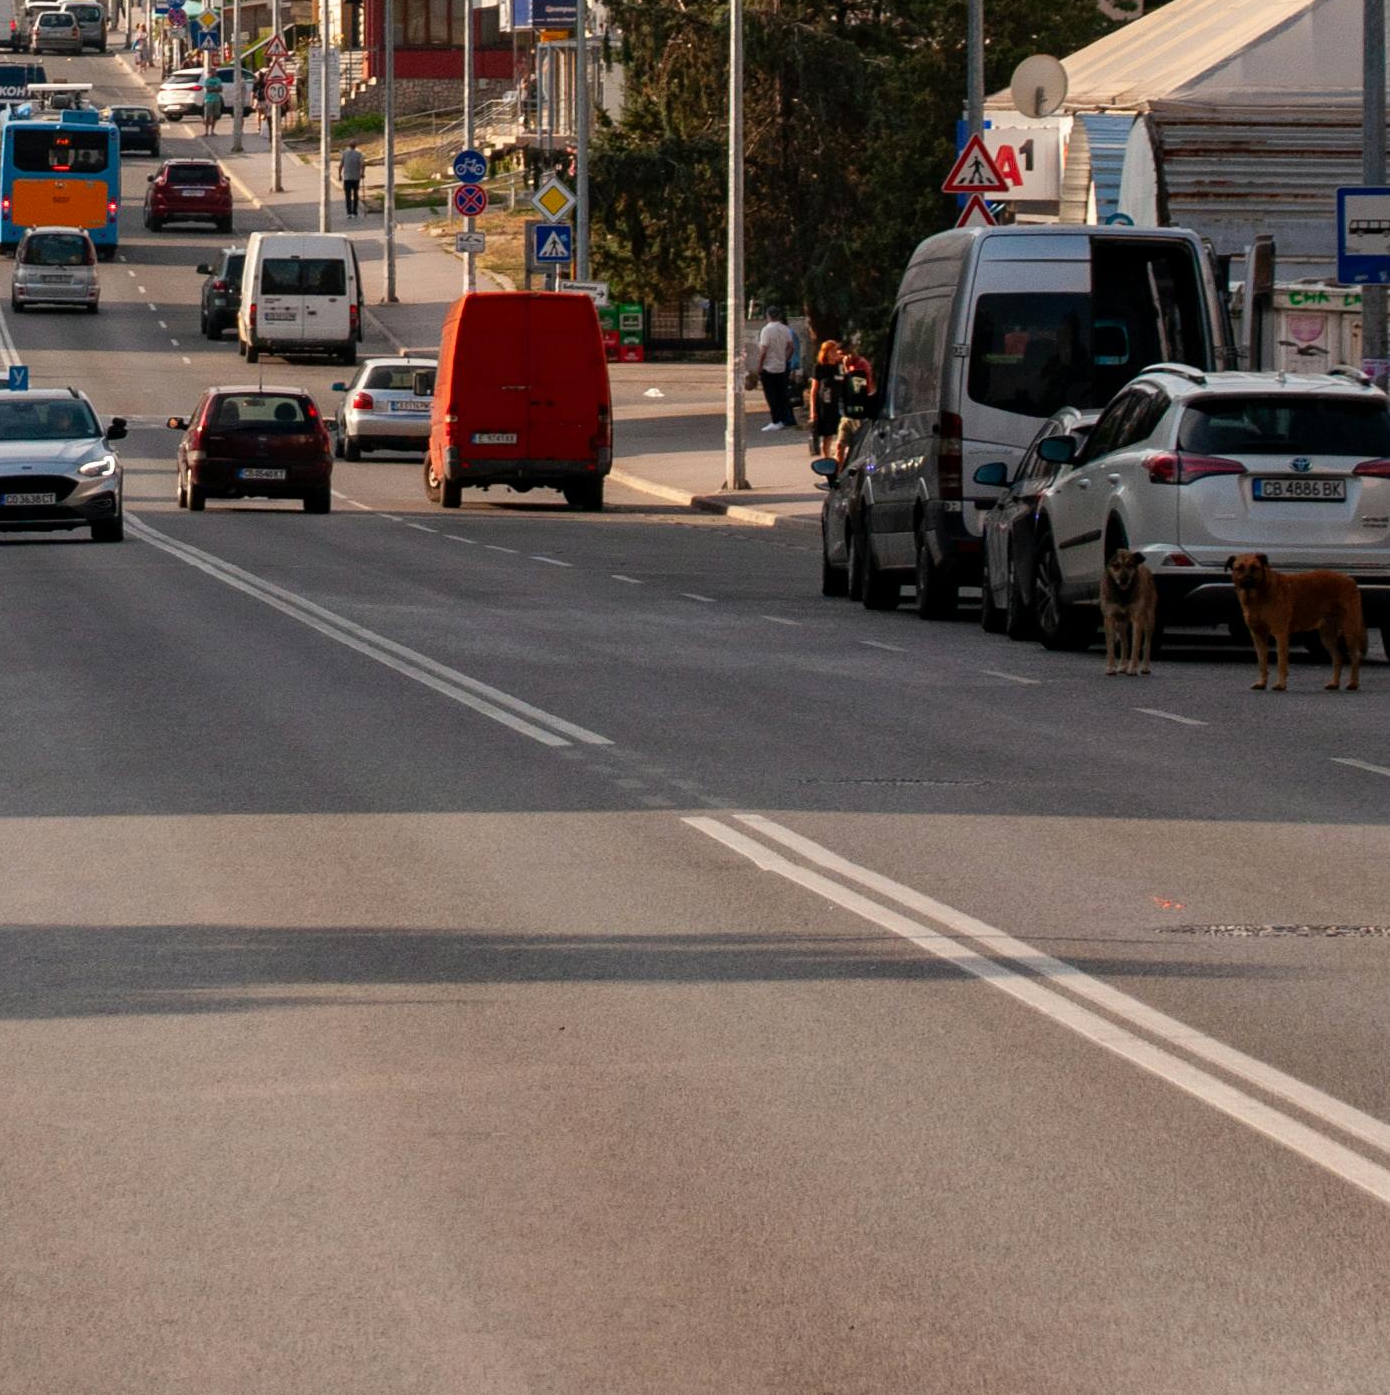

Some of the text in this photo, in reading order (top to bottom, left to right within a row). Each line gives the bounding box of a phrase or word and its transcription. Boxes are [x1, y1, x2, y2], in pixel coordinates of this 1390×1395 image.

[995, 139, 1034, 186] A1
[1263, 482, 1341, 496] CB 4886 BK
